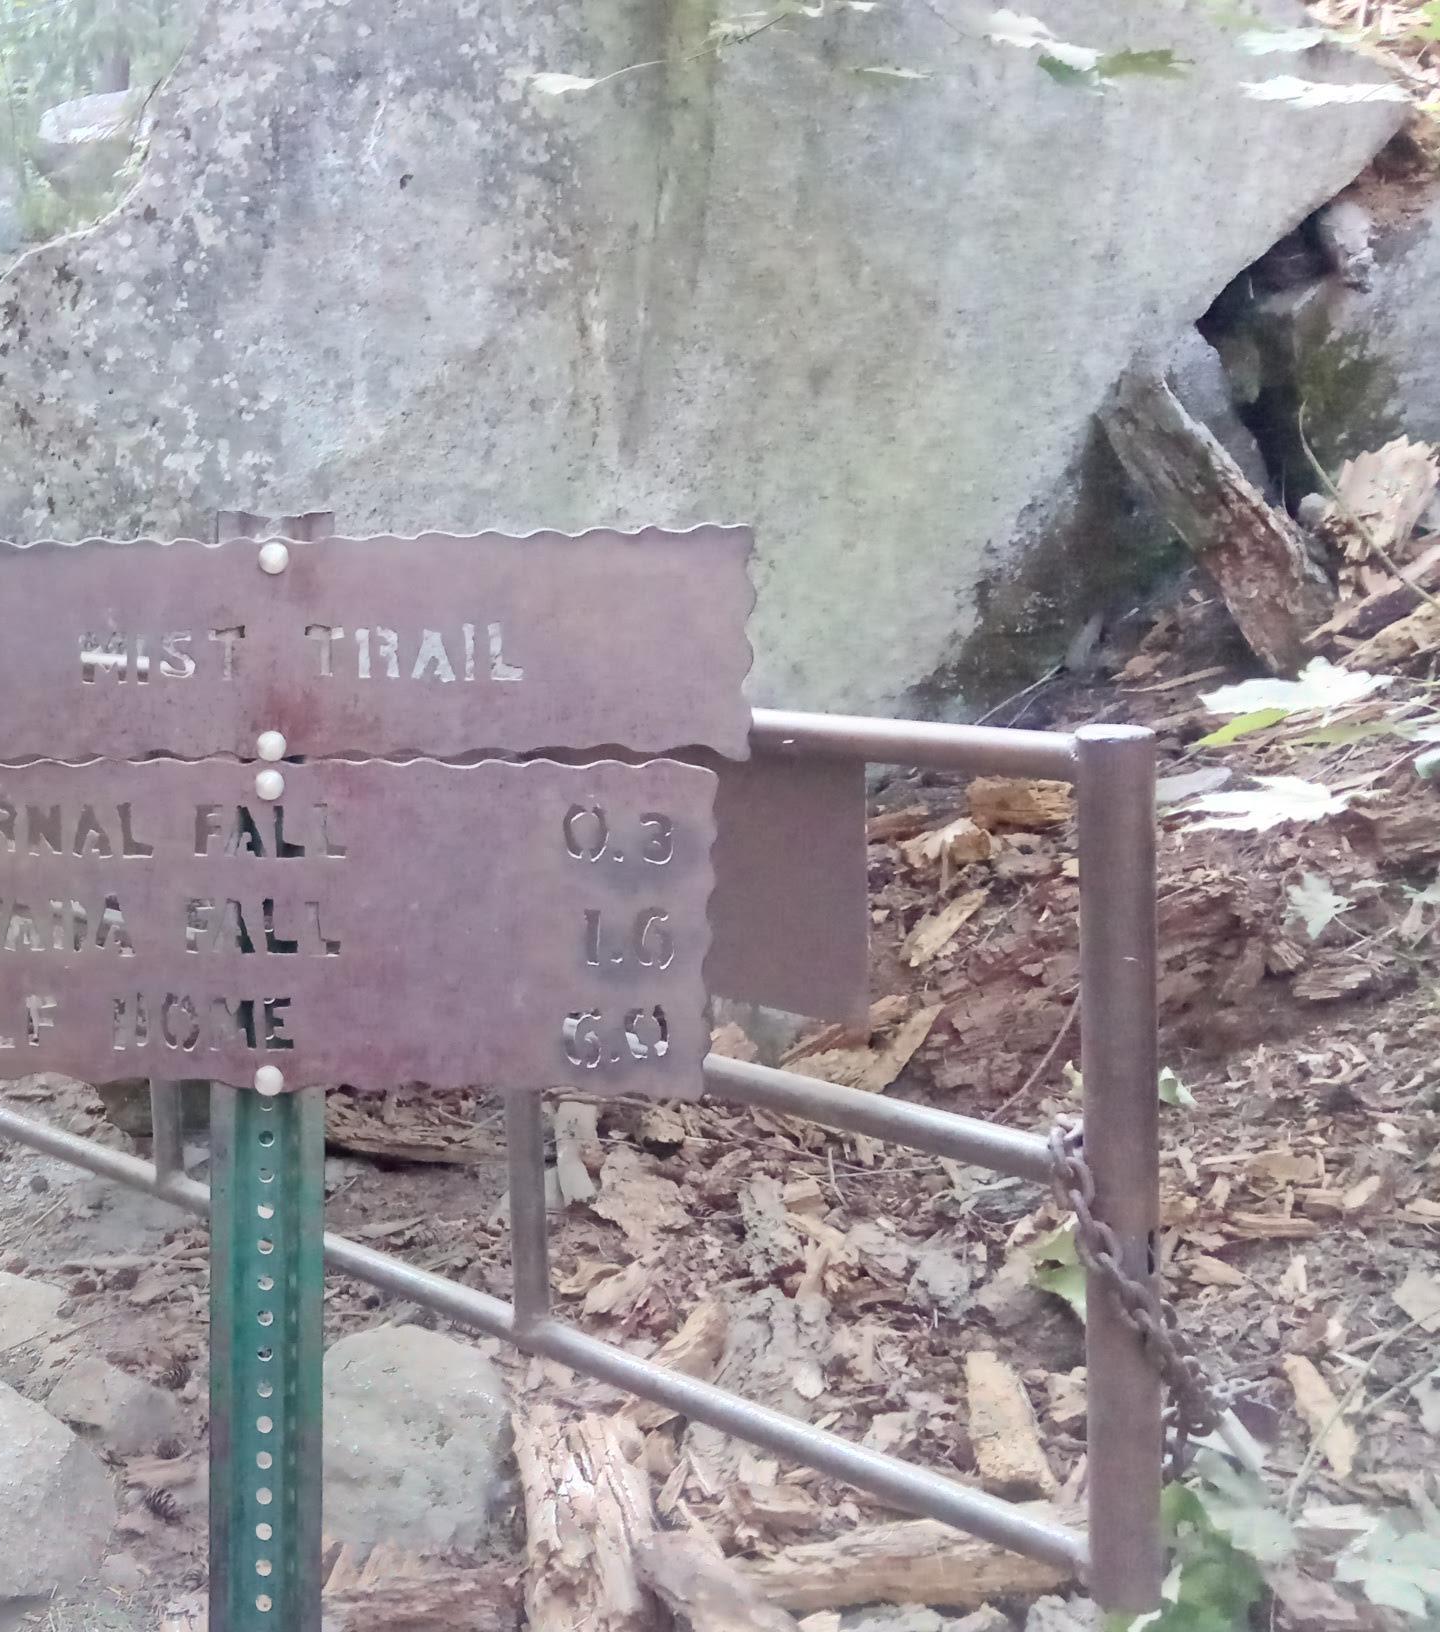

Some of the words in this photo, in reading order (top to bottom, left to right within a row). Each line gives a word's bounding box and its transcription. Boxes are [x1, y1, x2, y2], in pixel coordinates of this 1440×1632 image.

[78, 623, 247, 685] MIST
[304, 621, 525, 682] TRAIL
[193, 803, 348, 860] FALL
[563, 802, 675, 865] 0.3
[185, 897, 342, 958] FALL
[111, 991, 296, 1053] DOME
[562, 1003, 671, 1068] 6.0
